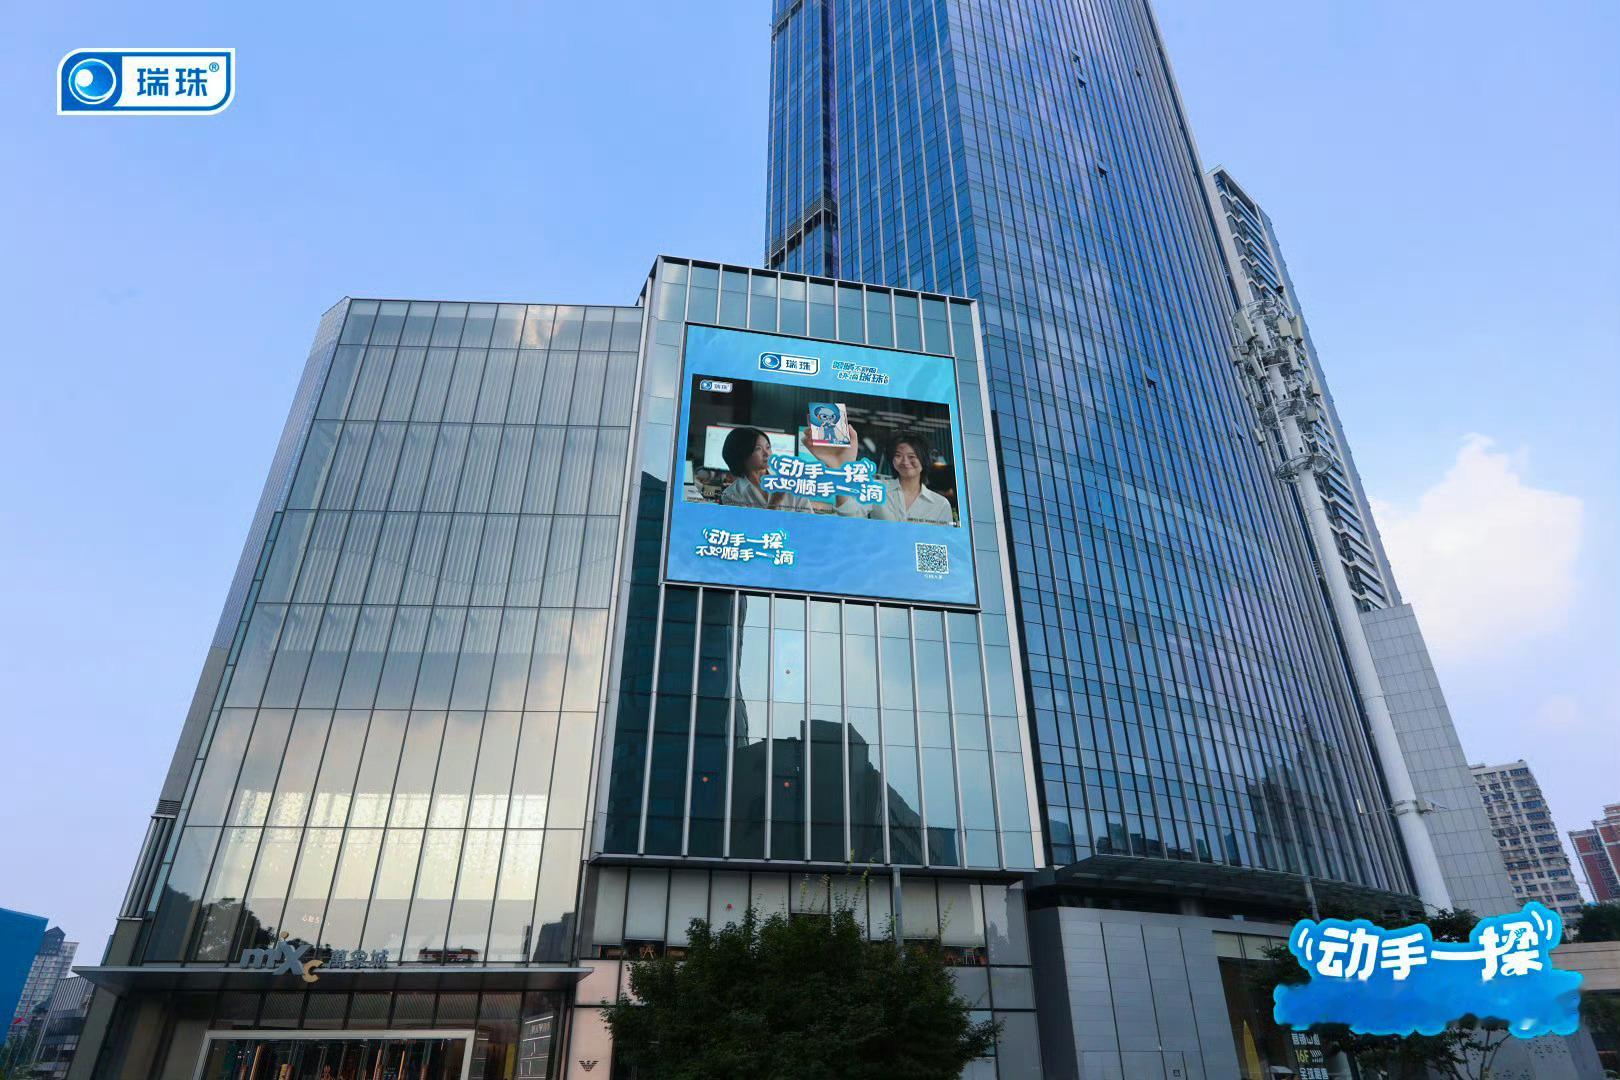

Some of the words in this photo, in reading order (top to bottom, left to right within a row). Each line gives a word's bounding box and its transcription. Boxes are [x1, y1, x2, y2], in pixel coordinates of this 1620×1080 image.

[764, 477, 883, 502] 不如顺手一滴
[695, 545, 795, 565] 不如顺手一滴
